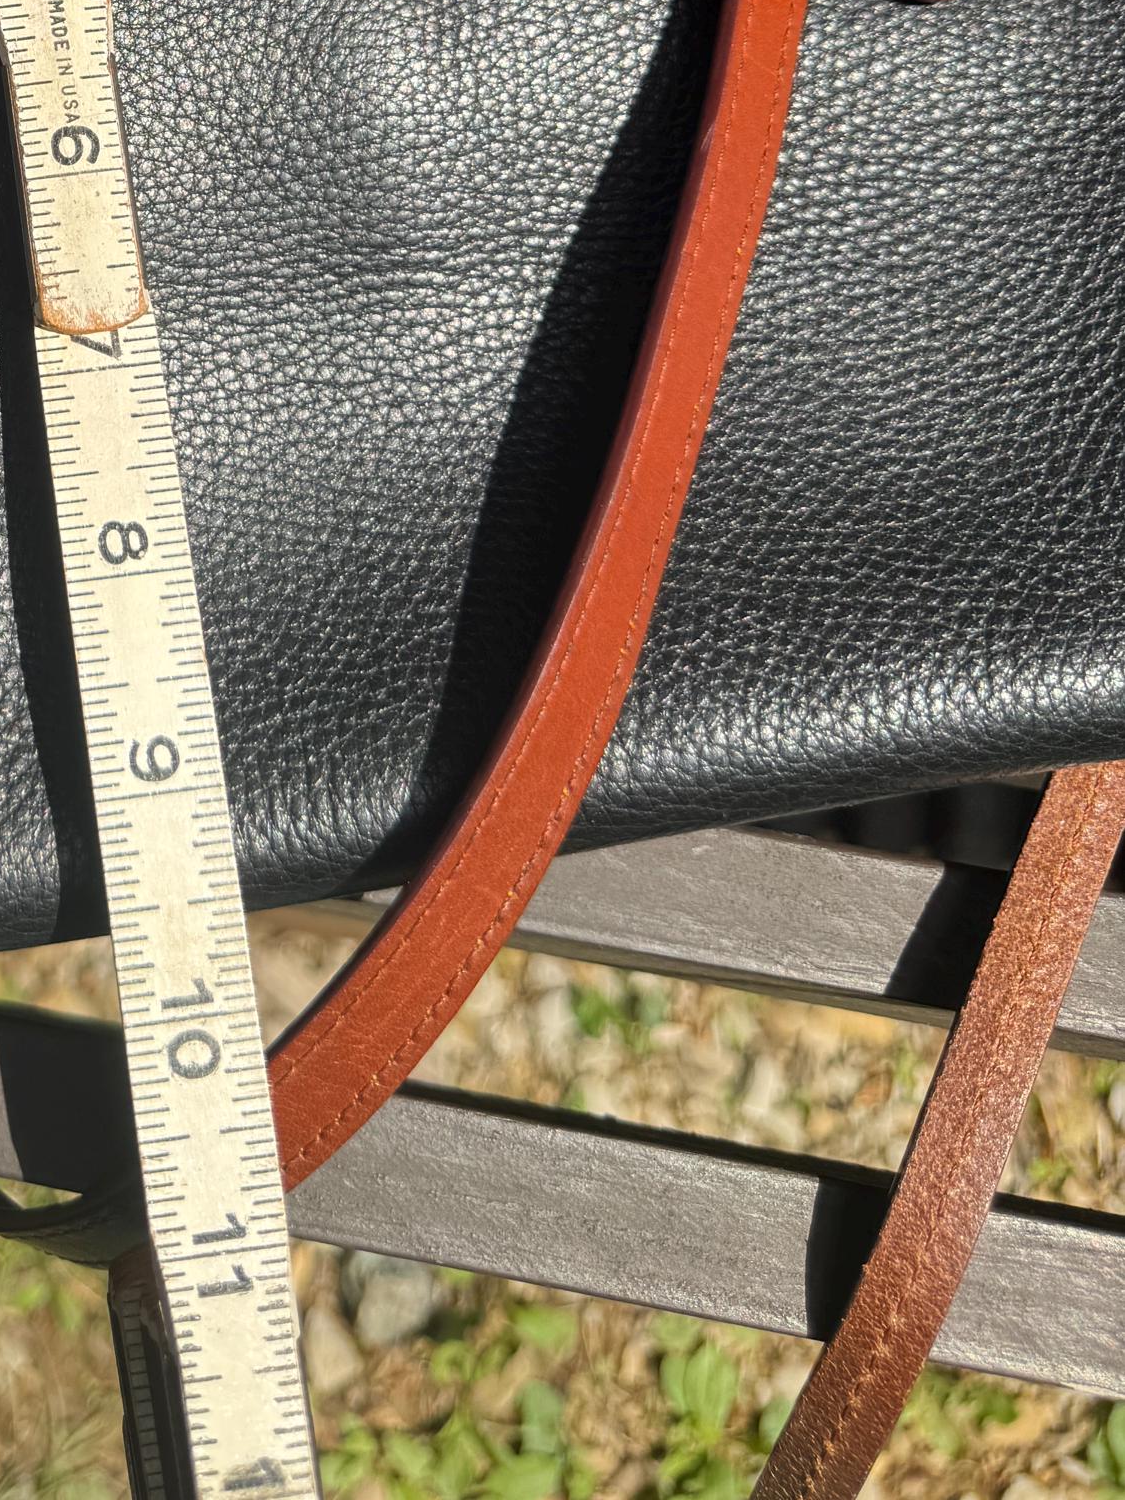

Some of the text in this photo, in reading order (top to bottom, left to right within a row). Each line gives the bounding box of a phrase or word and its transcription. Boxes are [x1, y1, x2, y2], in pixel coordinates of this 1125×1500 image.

[47, 0, 81, 124] MADE IN USA
[50, 125, 101, 167] 6
[70, 329, 123, 361] 7
[97, 520, 149, 565] 8
[128, 734, 181, 783] 9
